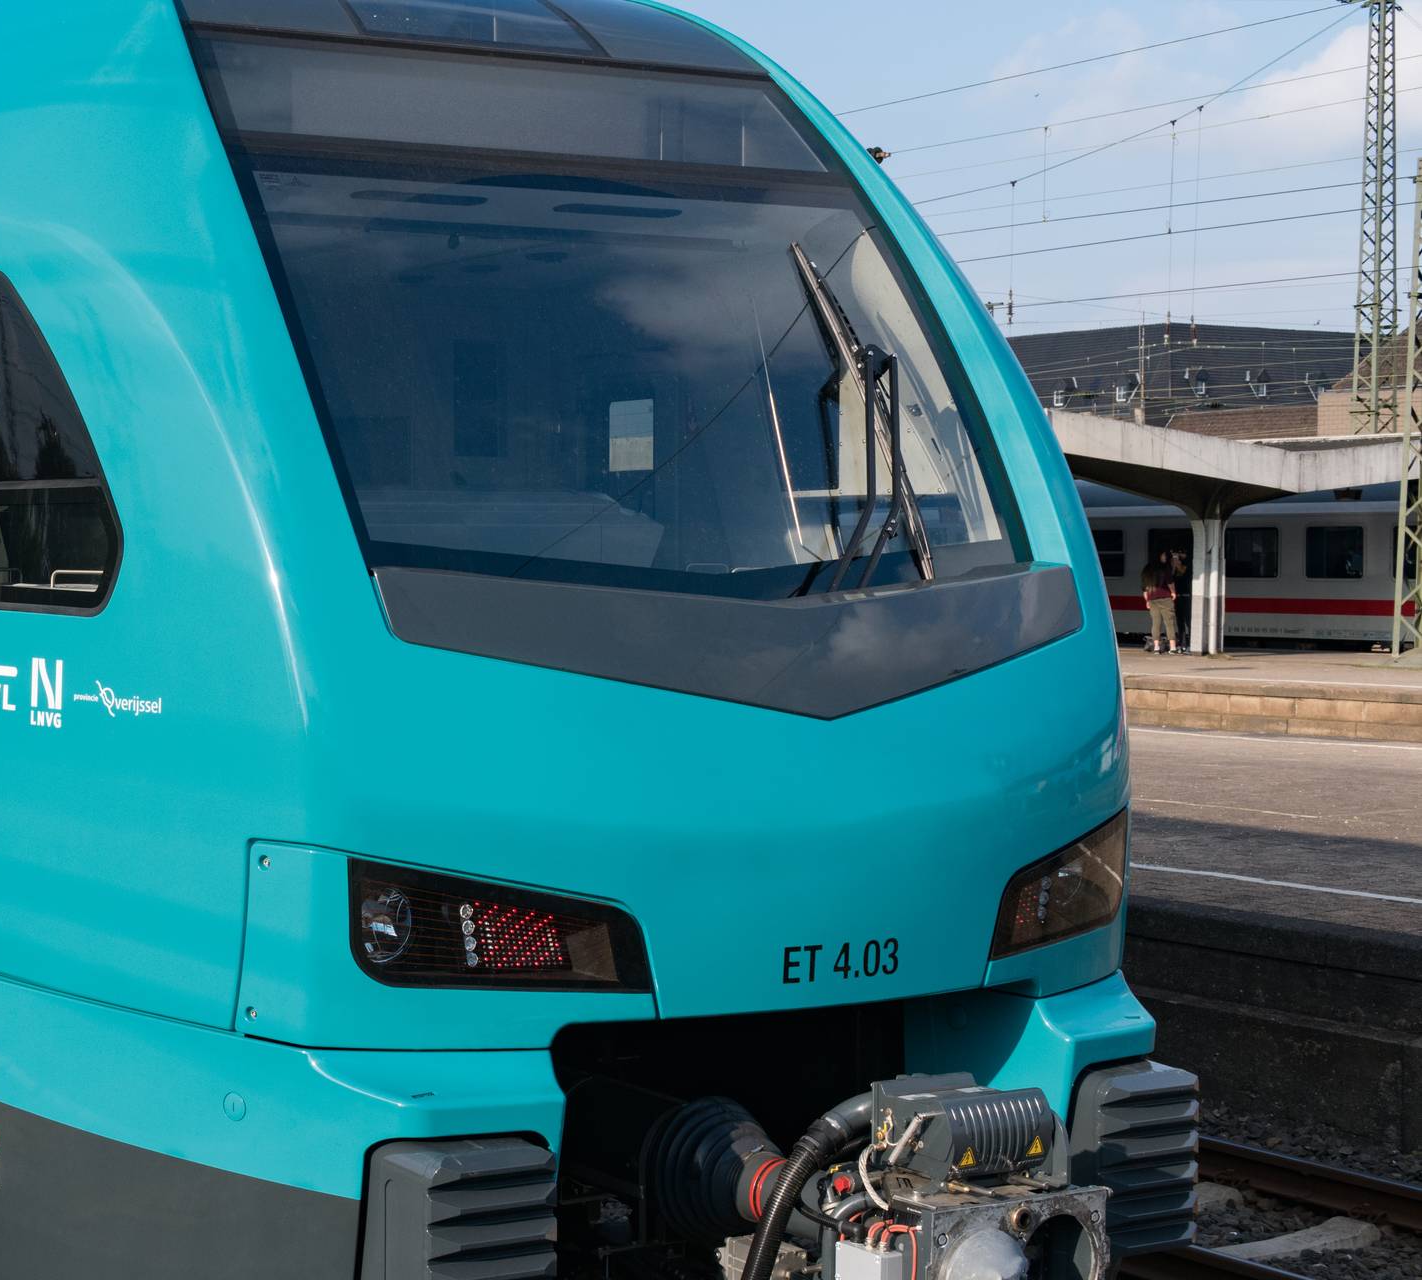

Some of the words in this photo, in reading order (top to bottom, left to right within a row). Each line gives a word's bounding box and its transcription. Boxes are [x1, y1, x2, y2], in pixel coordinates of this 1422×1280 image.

[73, 693, 99, 703] provincie
[30, 710, 63, 729] LNVG
[782, 944, 823, 985] ET
[833, 937, 900, 979] 4.03
